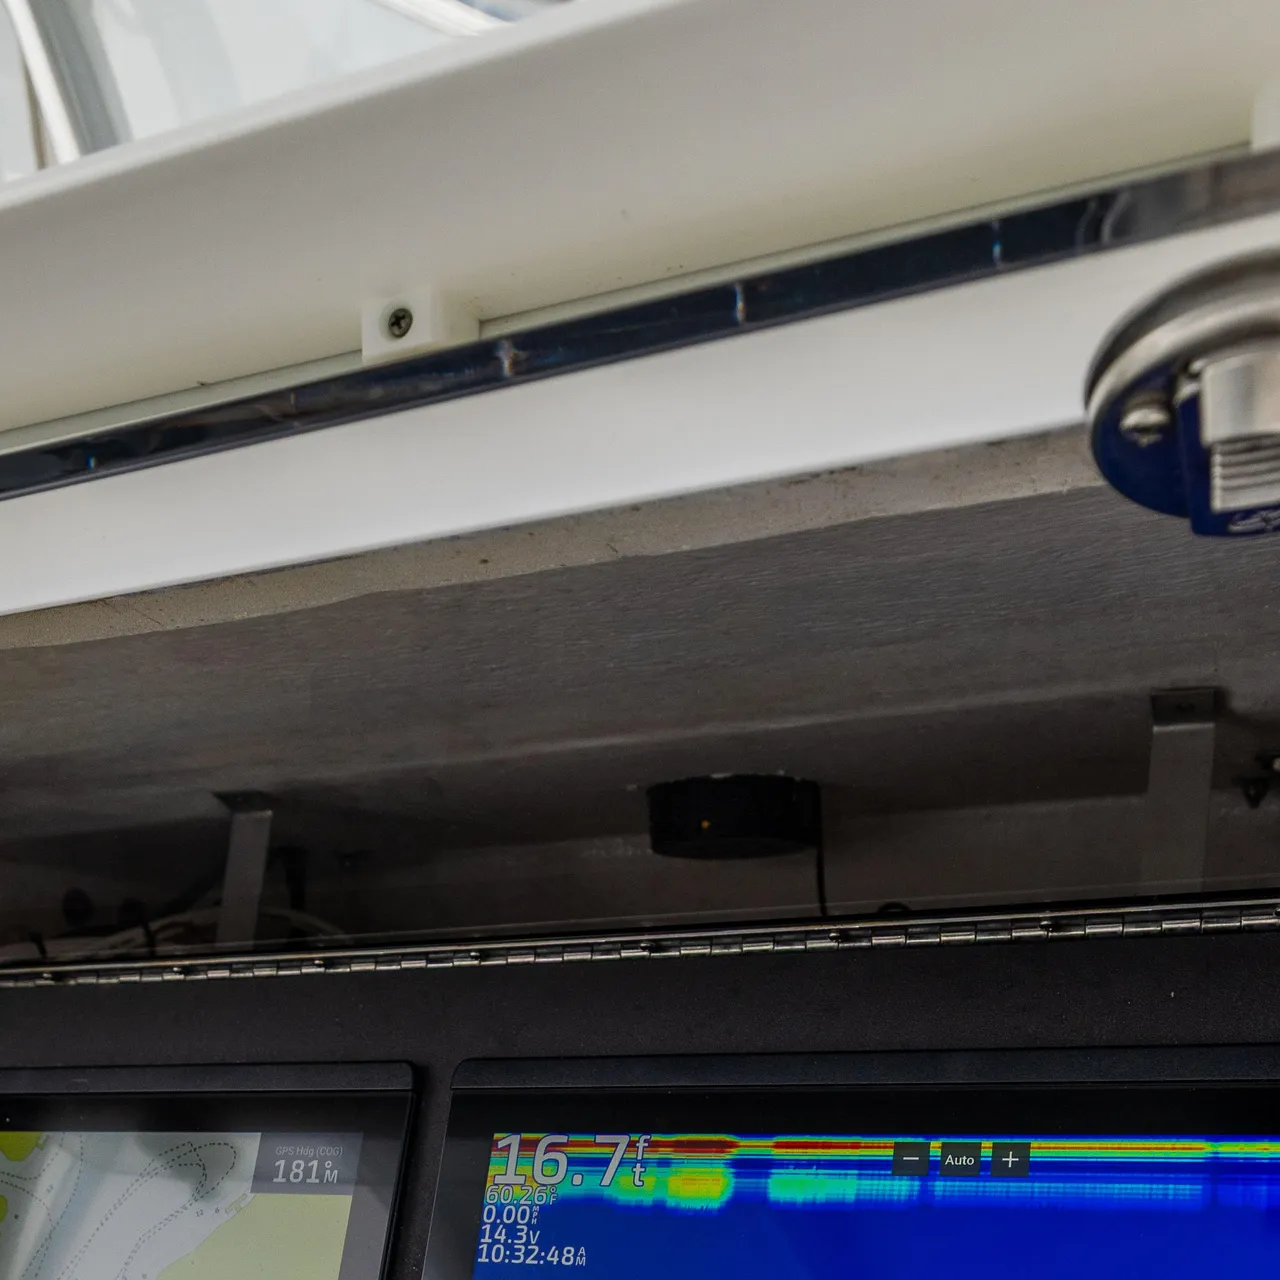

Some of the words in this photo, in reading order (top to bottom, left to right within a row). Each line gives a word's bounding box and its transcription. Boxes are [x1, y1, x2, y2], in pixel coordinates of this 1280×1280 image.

[275, 1146, 294, 1155] GPS
[296, 1146, 314, 1158] Hdg
[315, 1146, 343, 1157] (COG)
[945, 1154, 975, 1166] Auto
